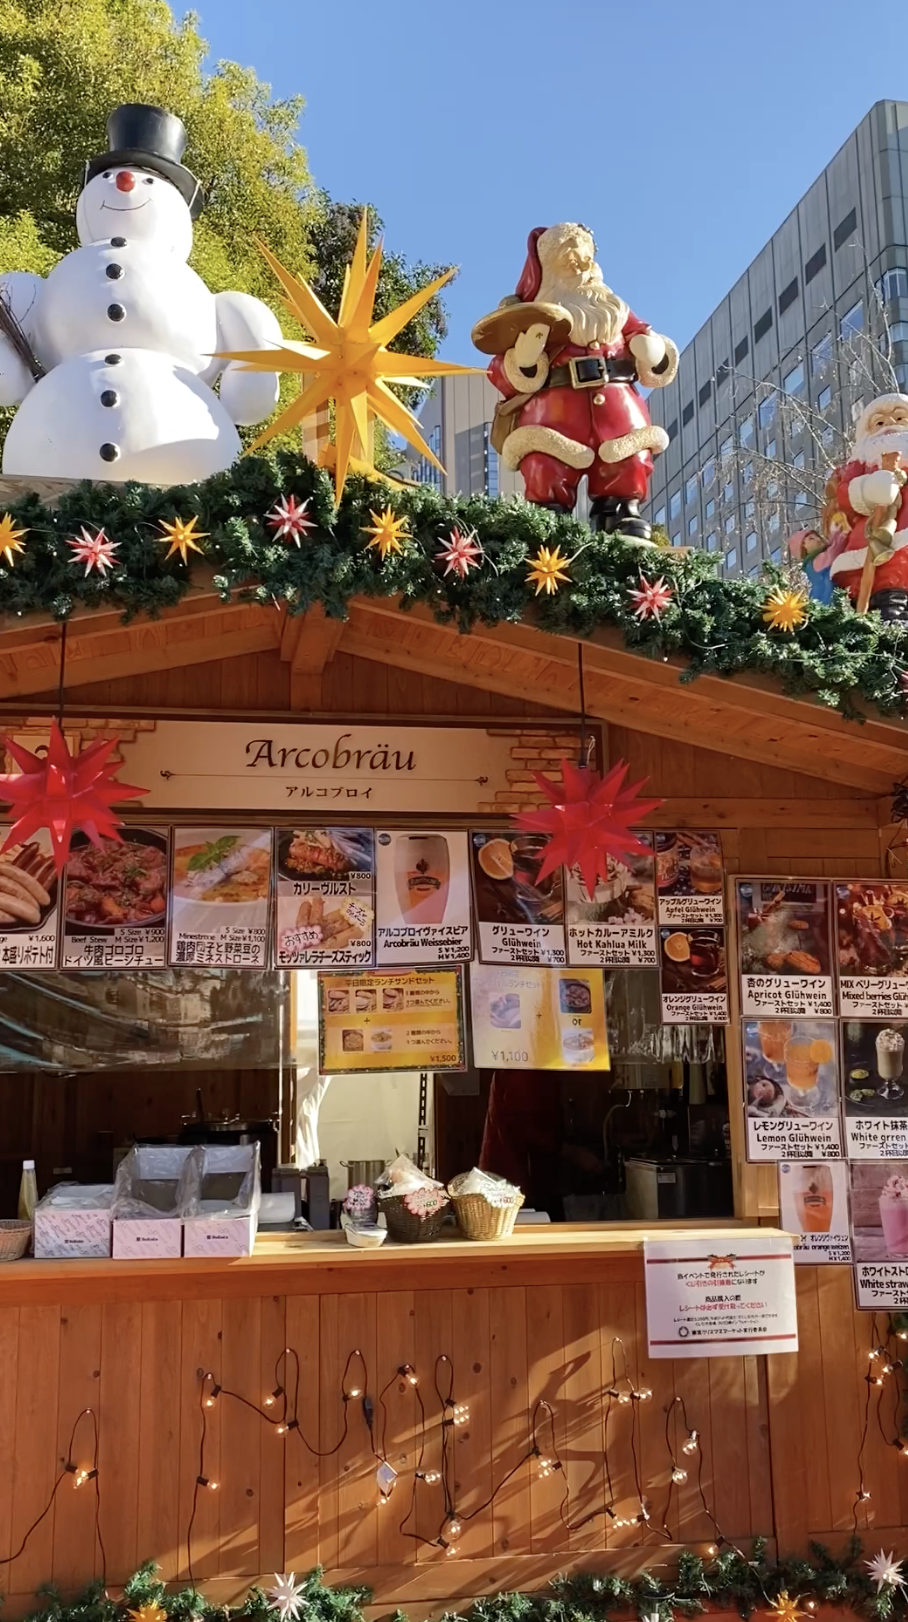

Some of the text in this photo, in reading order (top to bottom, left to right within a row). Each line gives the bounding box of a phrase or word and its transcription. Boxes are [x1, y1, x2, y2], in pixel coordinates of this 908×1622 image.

[245, 733, 417, 771] Arcobräu
[285, 785, 373, 799] アルコブロイ
[350, 872, 371, 880] ¥800
[293, 882, 356, 896] カリーヴルスト
[492, 926, 550, 937] グリューワイン
[569, 928, 654, 938] ホットカルーアミルク
[383, 939, 419, 948] Arcobräu
[501, 938, 541, 948] Glühwein
[577, 940, 647, 949] Hot Kahlua Milk
[0, 945, 53, 964] 本盛りポテト付
[84, 945, 143, 955] 牛肉ゴロゴロ
[492, 947, 539, 956] ファーストセット
[747, 978, 826, 989] 杏のグリューワイン
[840, 980, 854, 989] MIX
[748, 990, 827, 1001] Apricot Glühwein
[842, 991, 865, 1000] Mixed
[666, 1004, 690, 1012] Orange
[572, 1017, 583, 1026] or
[430, 1054, 457, 1063] ¥1,500
[491, 1050, 529, 1062] ¥1,100
[753, 1121, 833, 1131] レモングリューワイン
[756, 1133, 832, 1143] Lemon Glühwein
[851, 1132, 878, 1142] White
[860, 1279, 885, 1289] White
[872, 1290, 908, 1298] ファースト
